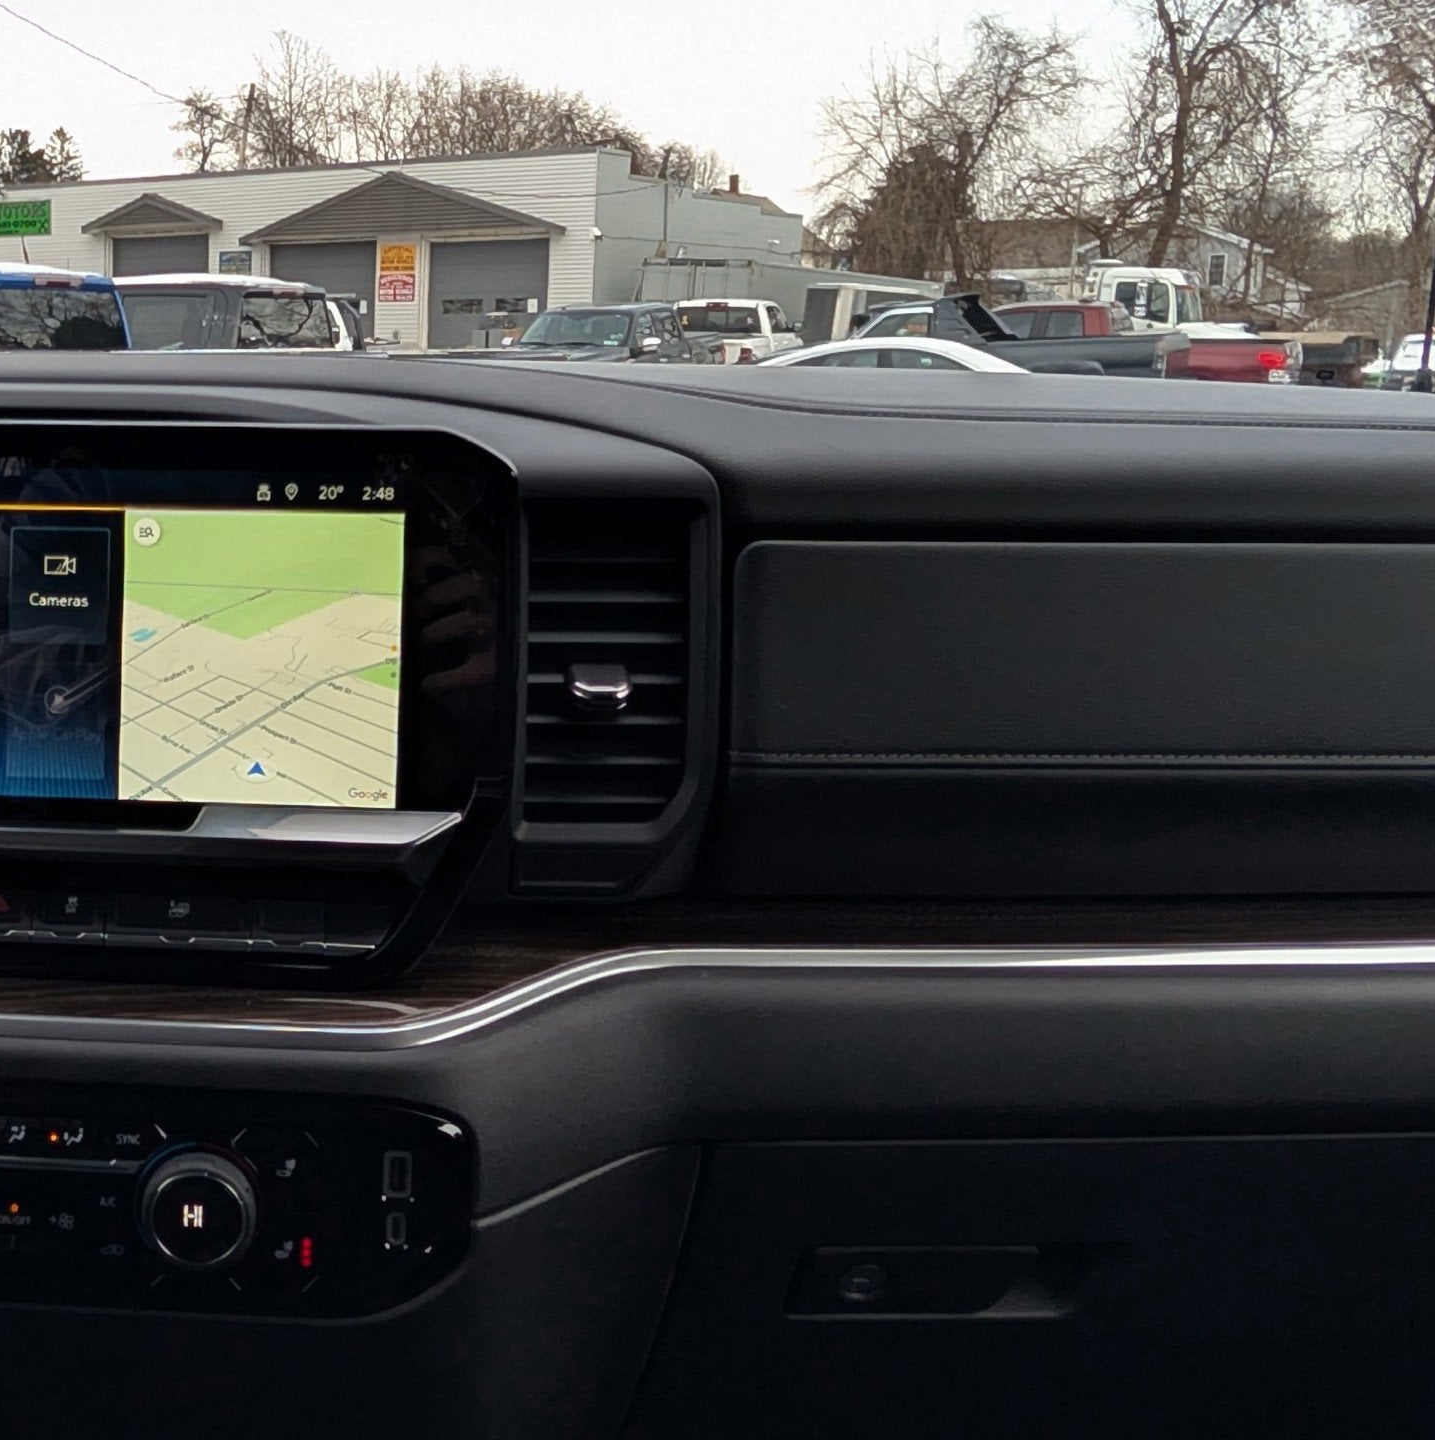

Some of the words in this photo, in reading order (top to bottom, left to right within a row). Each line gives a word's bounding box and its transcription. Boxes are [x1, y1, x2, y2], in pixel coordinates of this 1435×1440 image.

[362, 485, 396, 501] 2:48
[28, 592, 90, 609] Cameras
[347, 787, 389, 802] Google
[115, 1133, 141, 1147] SYNC
[181, 1203, 204, 1229] HI
